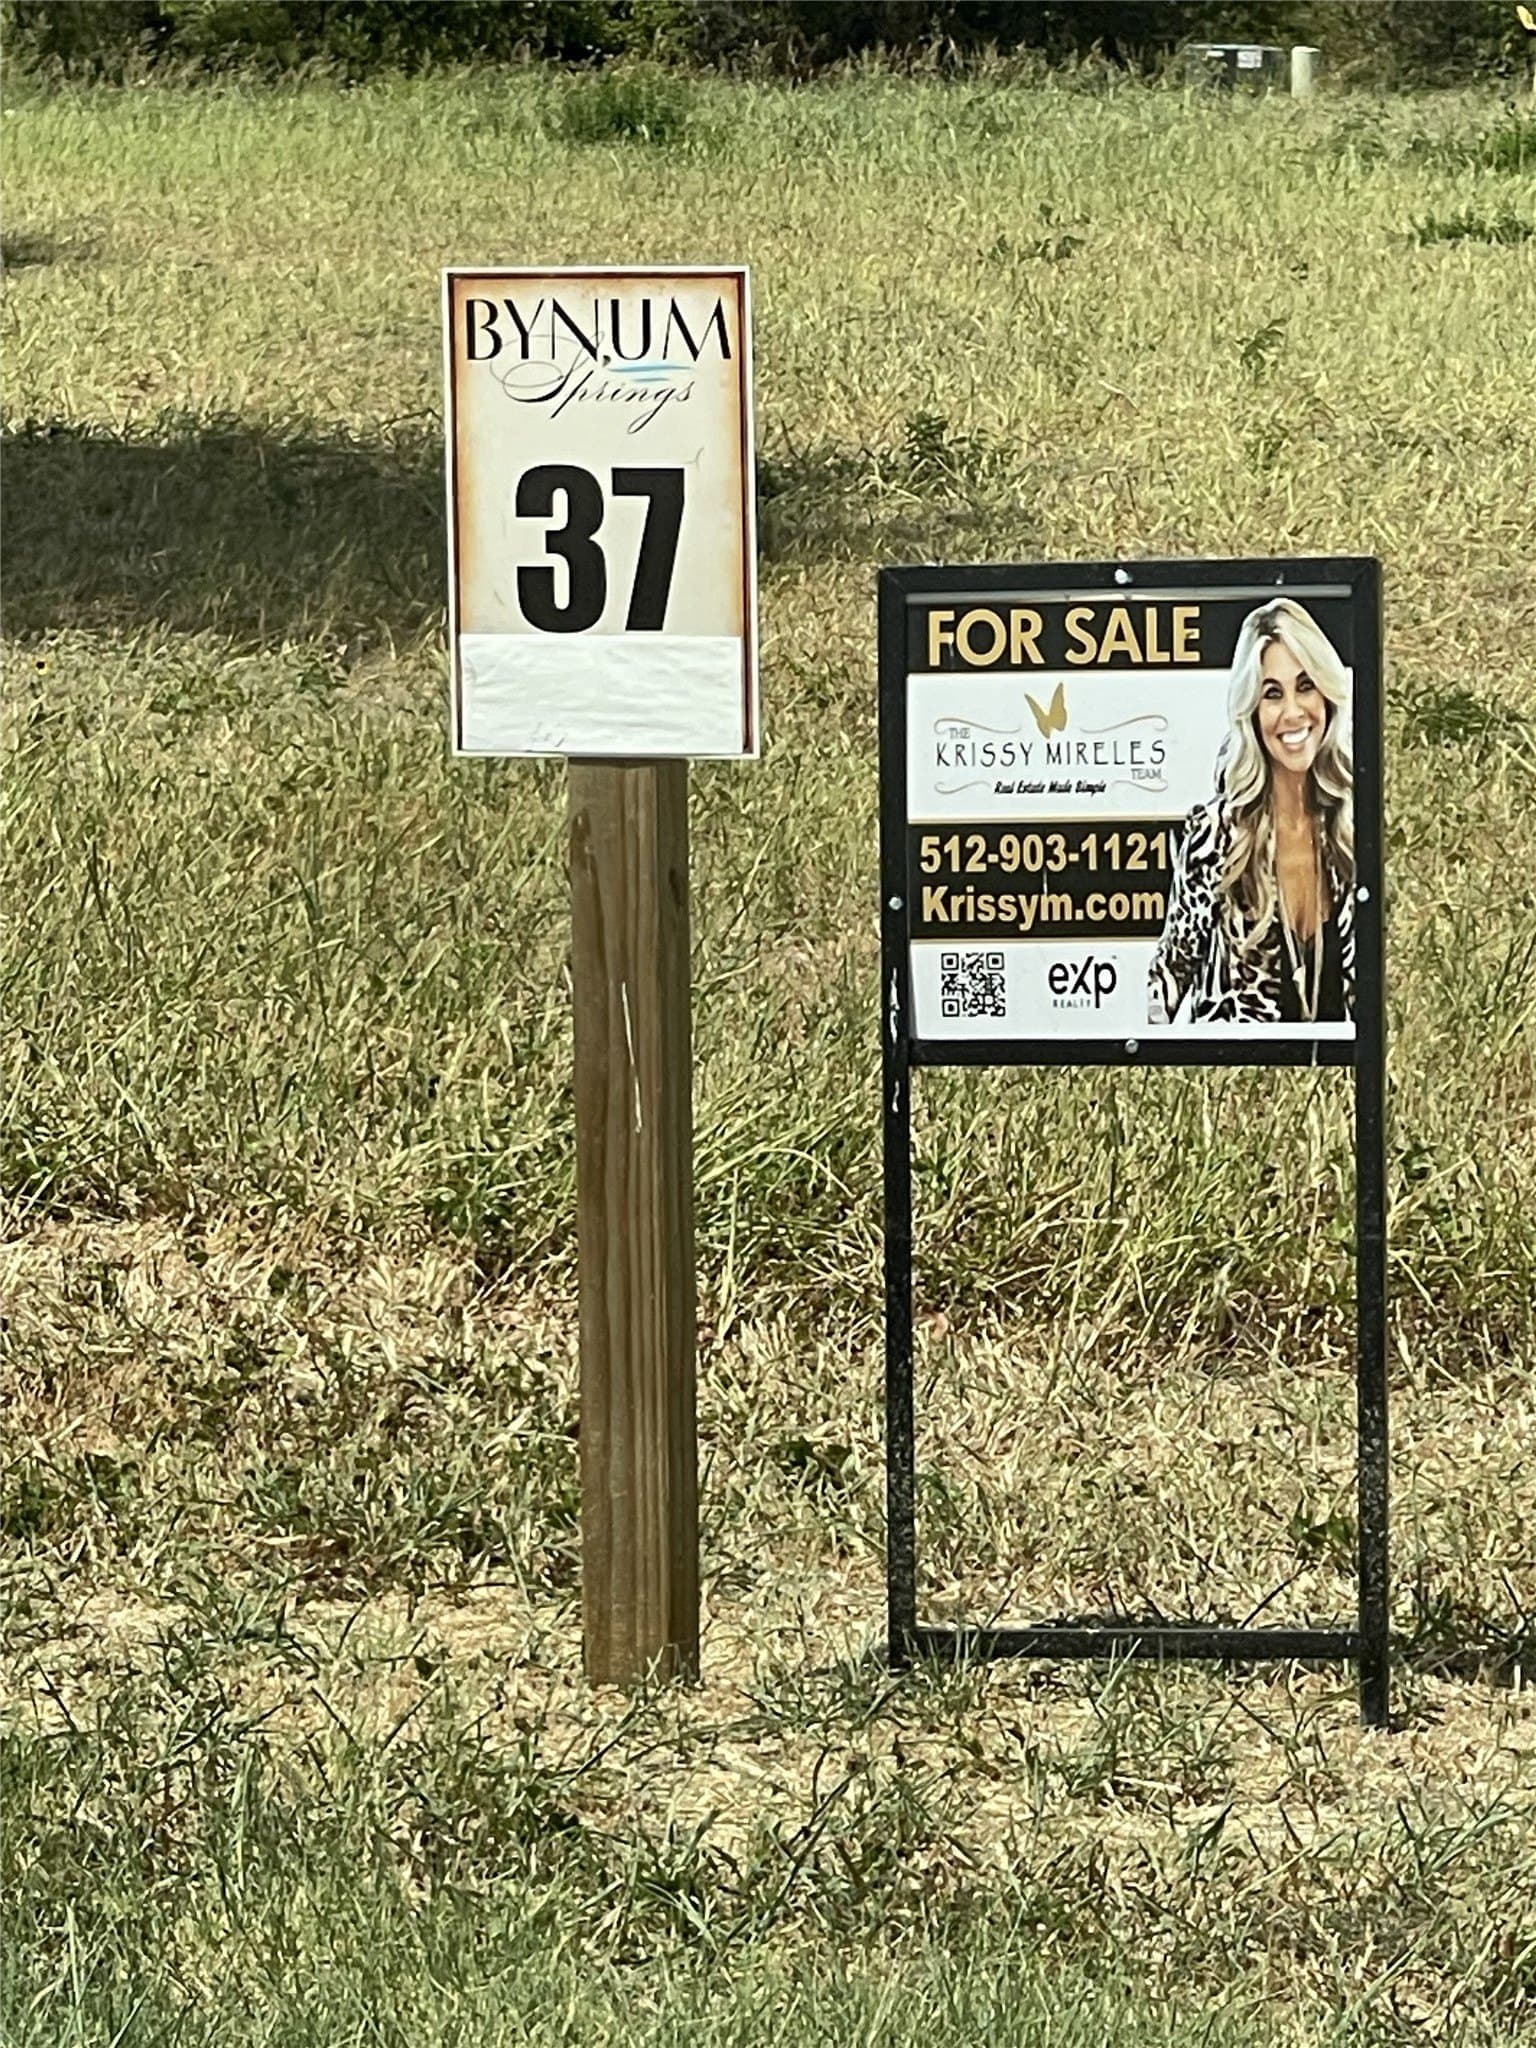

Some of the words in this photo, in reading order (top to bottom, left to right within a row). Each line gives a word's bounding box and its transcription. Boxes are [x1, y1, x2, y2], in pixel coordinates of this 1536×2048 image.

[466, 297, 732, 361] BYNUM
[490, 331, 696, 434] Springs
[515, 464, 685, 633] 37
[928, 608, 1045, 667] FOR
[1064, 606, 1201, 664] SALE
[936, 742, 1034, 768] KRISSY
[1046, 740, 1167, 766] MIRELES
[949, 728, 971, 740] THE
[1130, 768, 1163, 781] TEAM
[920, 832, 1168, 873] 512-903-1121
[922, 886, 1165, 932] Krissym.com
